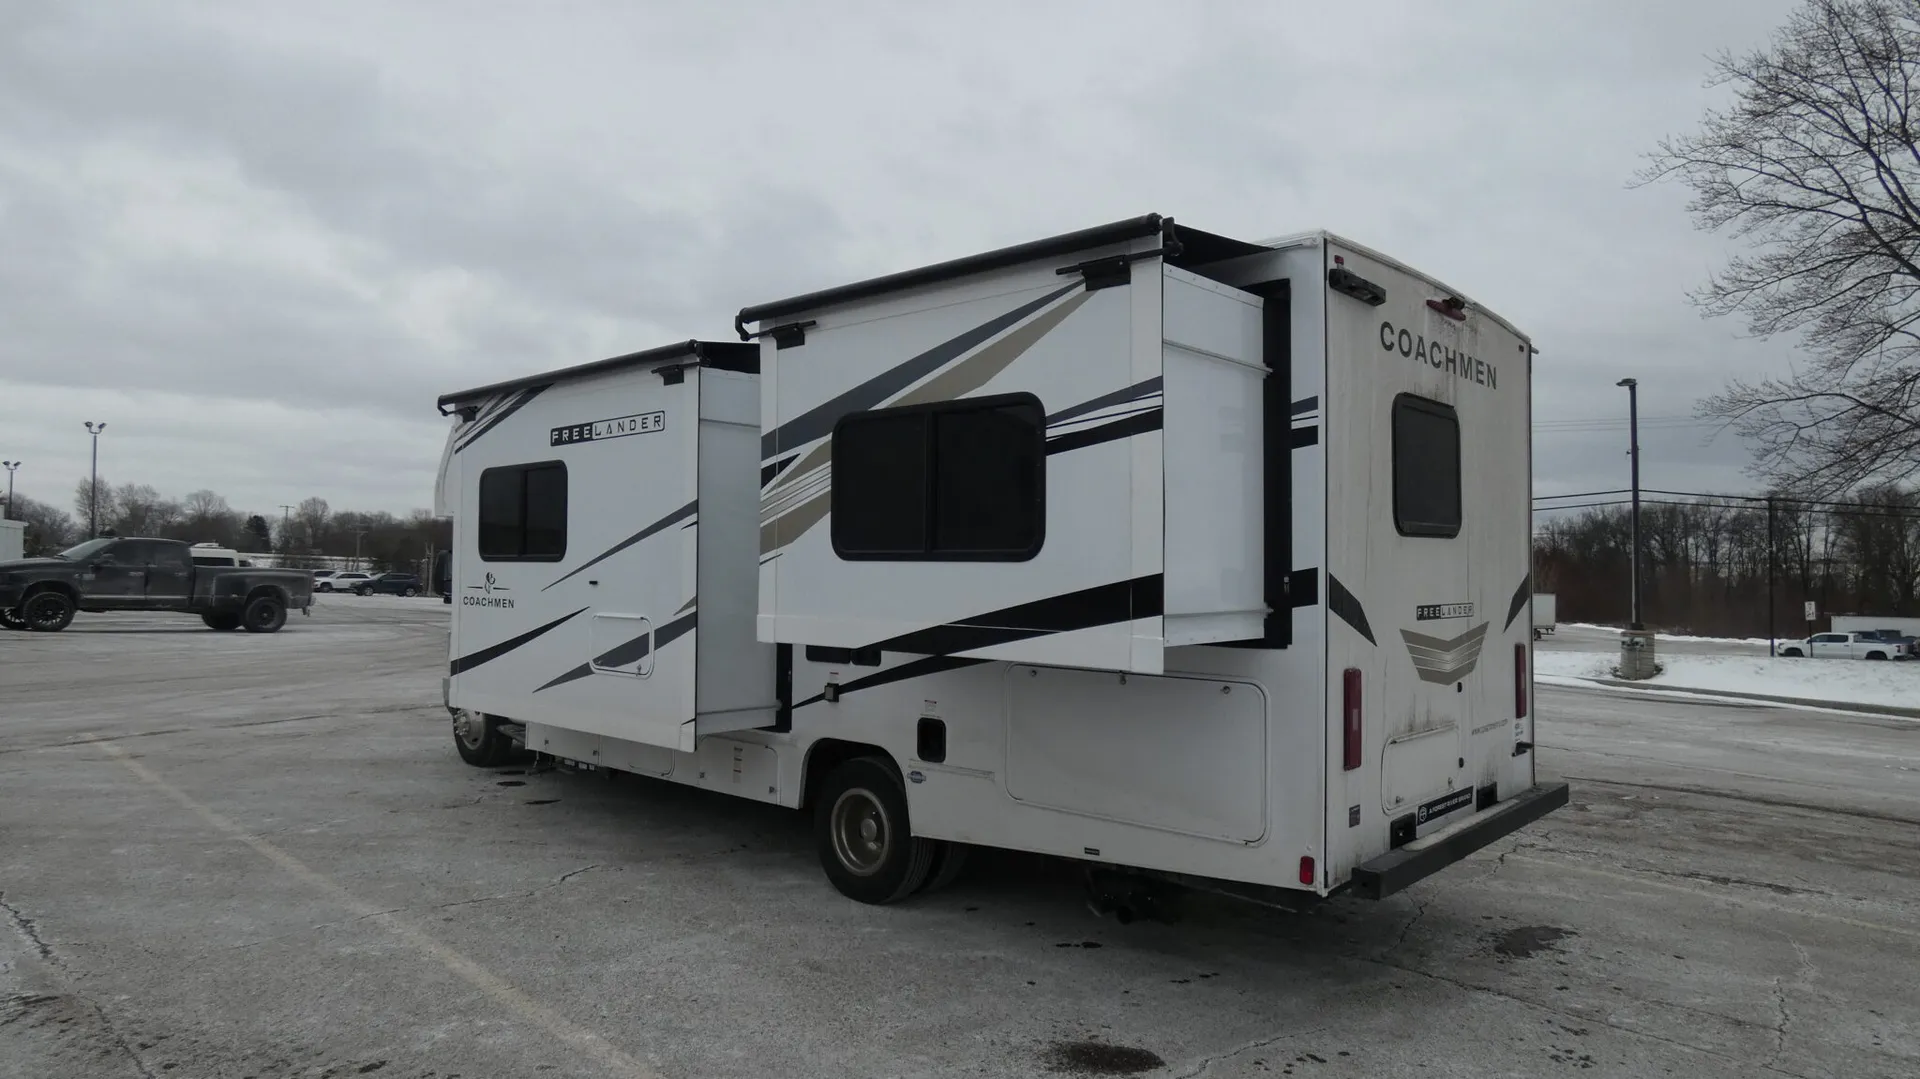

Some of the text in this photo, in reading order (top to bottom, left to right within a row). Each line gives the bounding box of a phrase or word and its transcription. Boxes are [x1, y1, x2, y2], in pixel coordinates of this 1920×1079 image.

[1380, 321, 1497, 390] COACHMEN
[551, 415, 661, 443] FREELANDER
[463, 596, 514, 608] COACHMEN
[1417, 604, 1472, 618] FREELANDER
